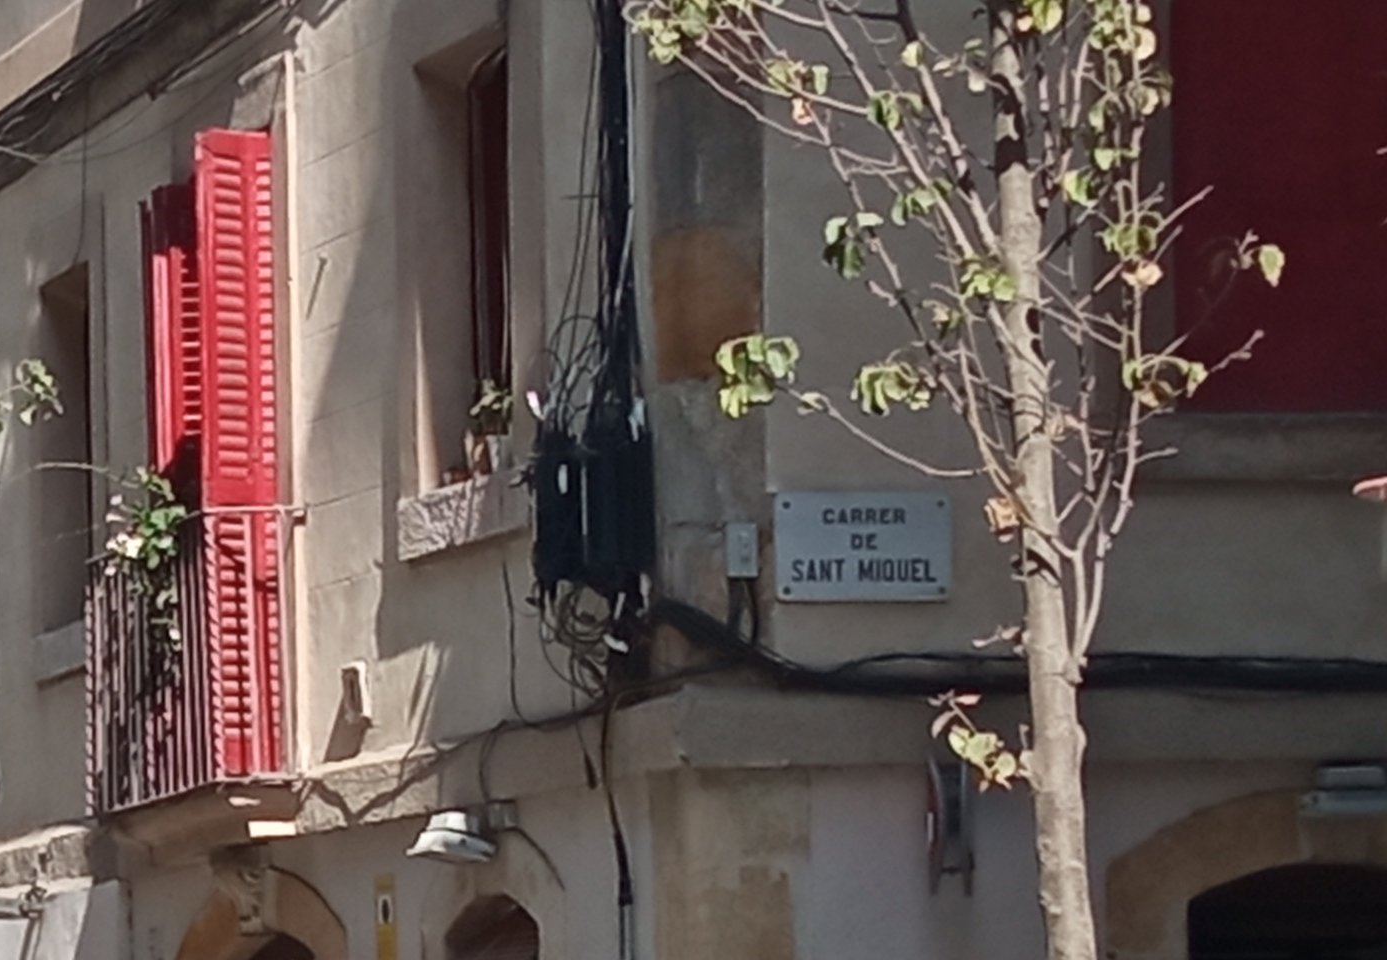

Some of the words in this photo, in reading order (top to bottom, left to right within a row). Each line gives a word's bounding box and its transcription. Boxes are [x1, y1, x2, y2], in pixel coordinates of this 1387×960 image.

[822, 508, 907, 525] CARRER
[850, 533, 878, 550] DE
[791, 558, 845, 582] SANT
[857, 558, 937, 582] MIQUEL
